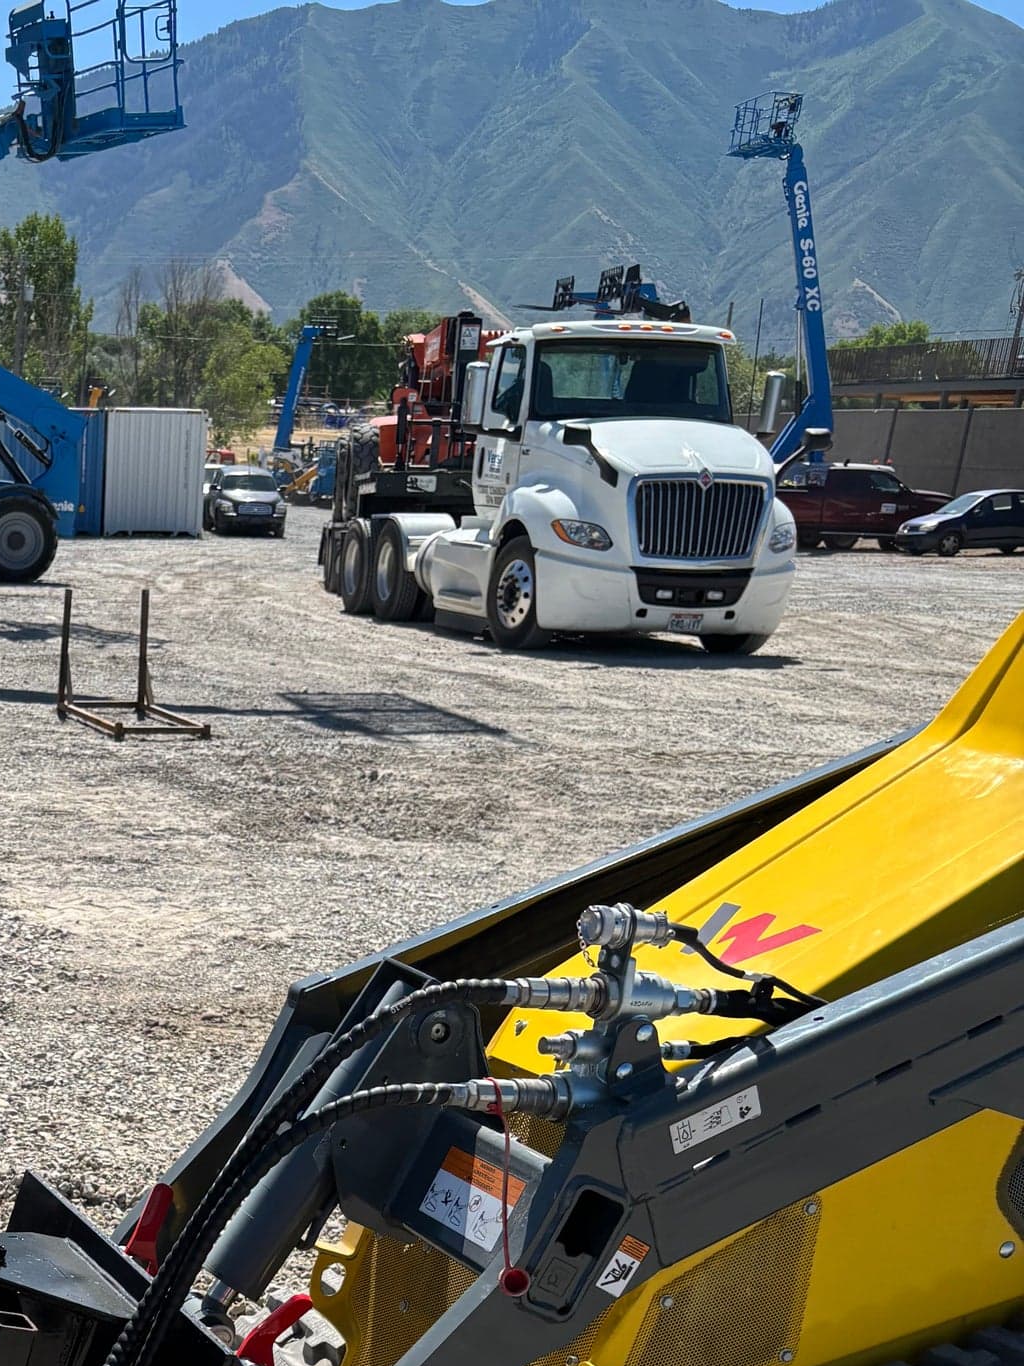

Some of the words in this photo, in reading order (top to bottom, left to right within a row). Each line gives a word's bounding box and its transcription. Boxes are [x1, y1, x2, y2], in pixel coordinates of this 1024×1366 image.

[793, 180, 810, 231] Genie
[799, 238, 817, 279] S-60
[805, 287, 821, 312] XC
